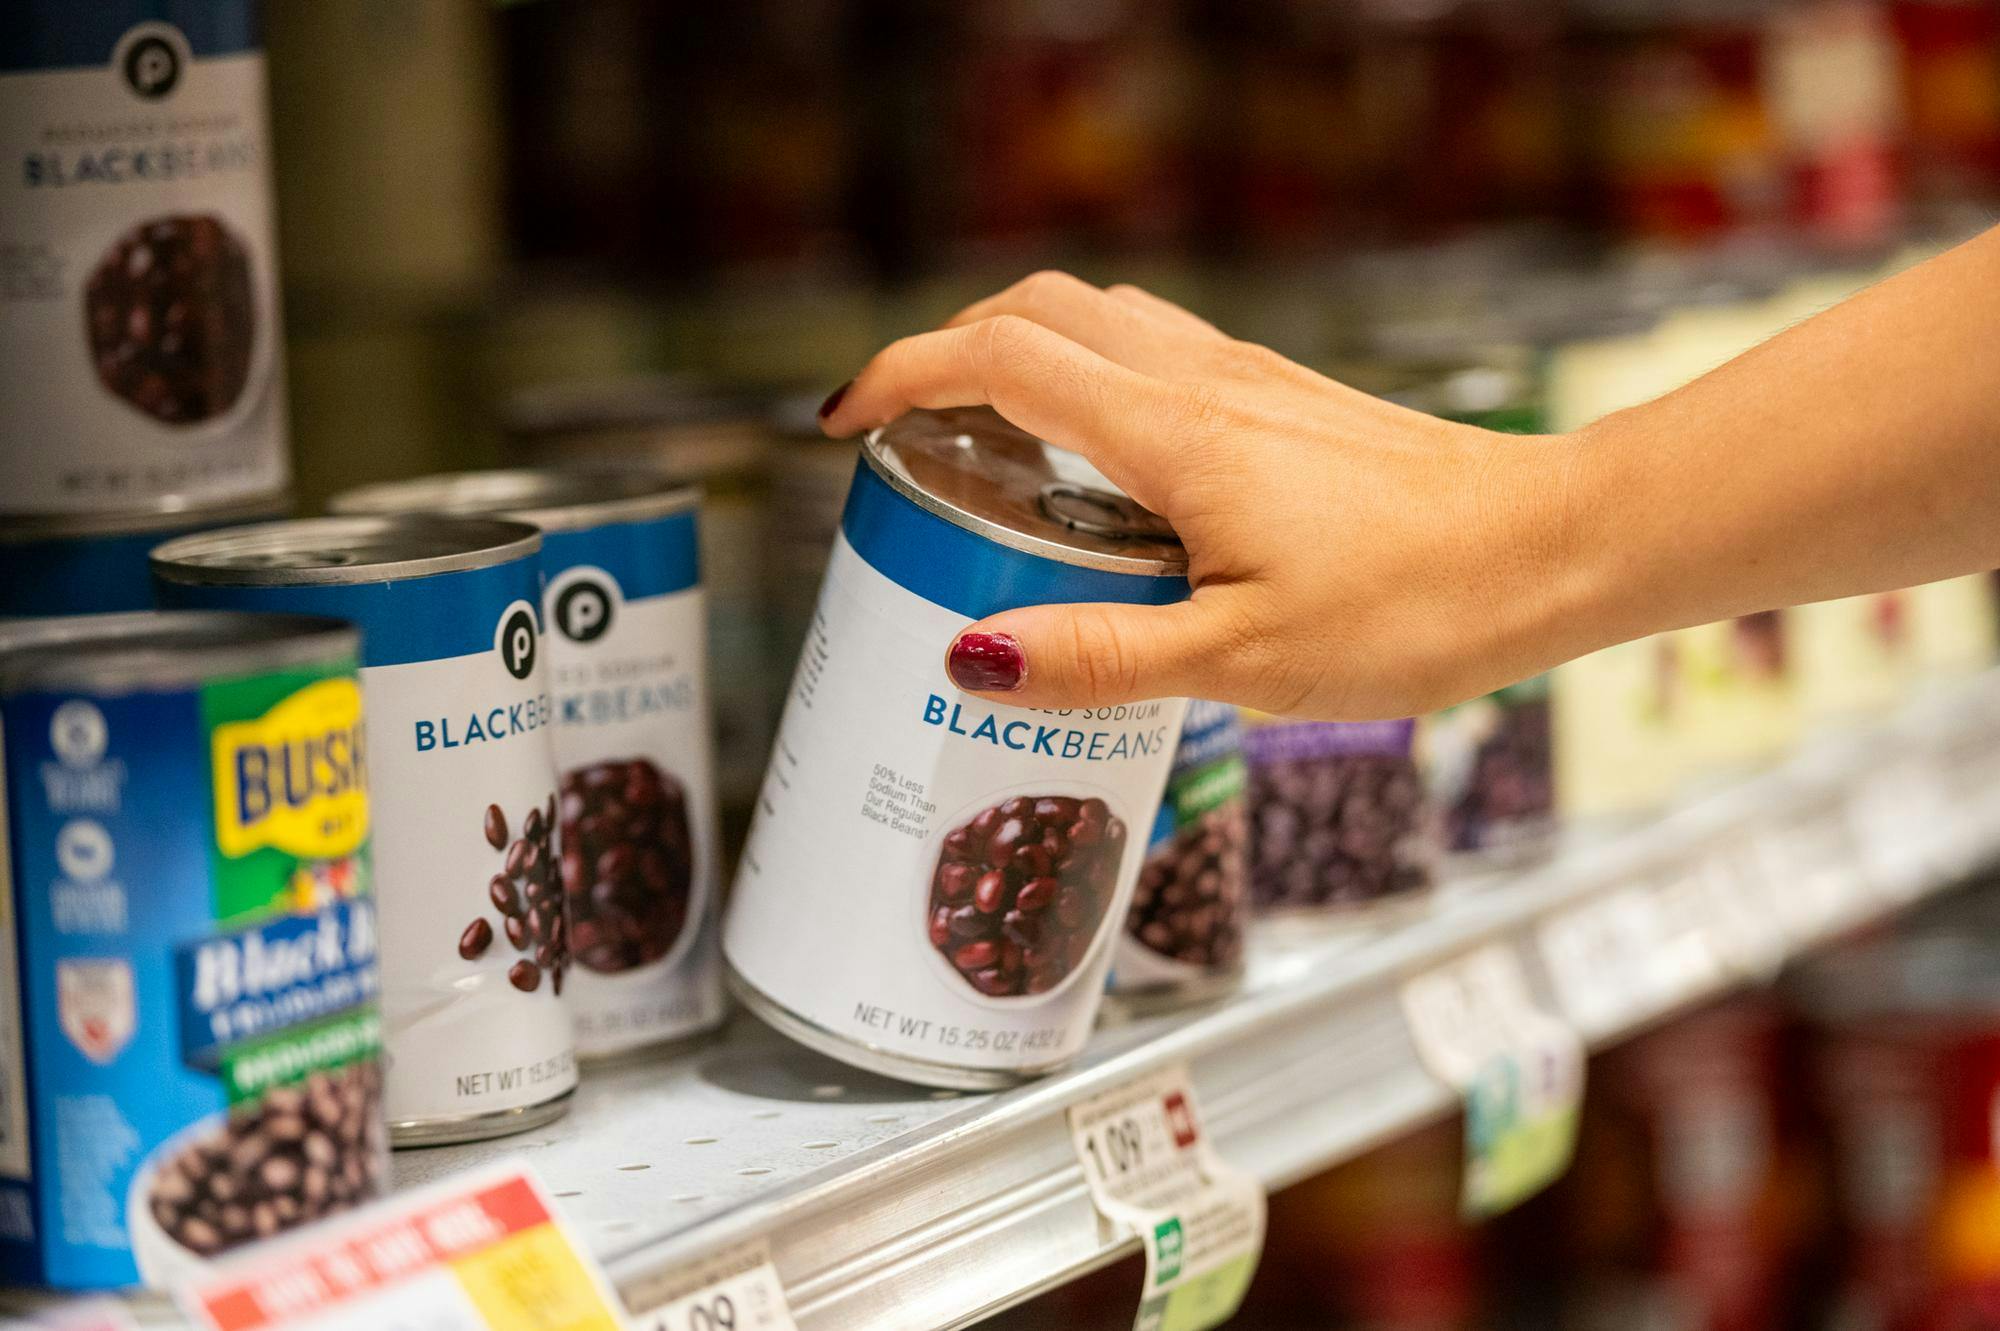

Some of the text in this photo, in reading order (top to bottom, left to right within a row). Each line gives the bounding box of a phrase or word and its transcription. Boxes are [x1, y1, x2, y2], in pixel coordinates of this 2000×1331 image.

[922, 694, 1166, 760] BLACKBEANS
[868, 776, 937, 813] Sodium Than
[872, 763, 924, 794] 50% Less
[861, 803, 888, 824] Black
[865, 790, 927, 824] Our Regular
[855, 1002, 897, 1030] NET
[899, 1015, 933, 1040] WT
[938, 1025, 990, 1050] 15.25
[992, 1029, 1019, 1052] OZ
[456, 1072, 492, 1097] NET
[497, 1066, 524, 1091] WT
